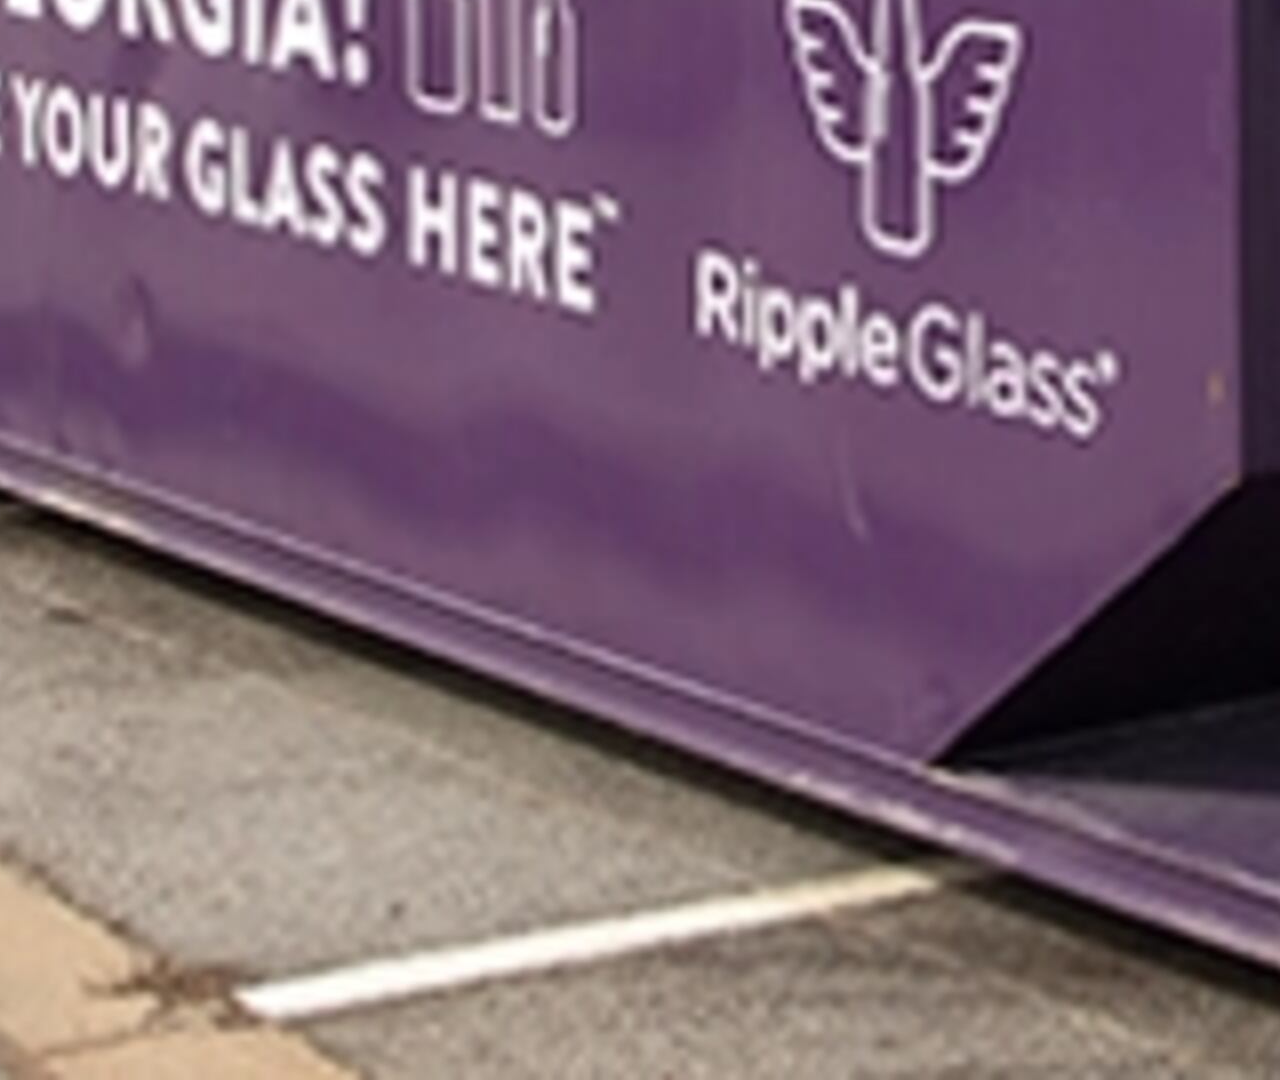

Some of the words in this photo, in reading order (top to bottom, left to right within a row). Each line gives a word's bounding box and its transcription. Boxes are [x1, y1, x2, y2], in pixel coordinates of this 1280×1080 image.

[10, 75, 172, 201] YOUR
[183, 119, 385, 258] GLASS
[405, 166, 597, 314] HERE
